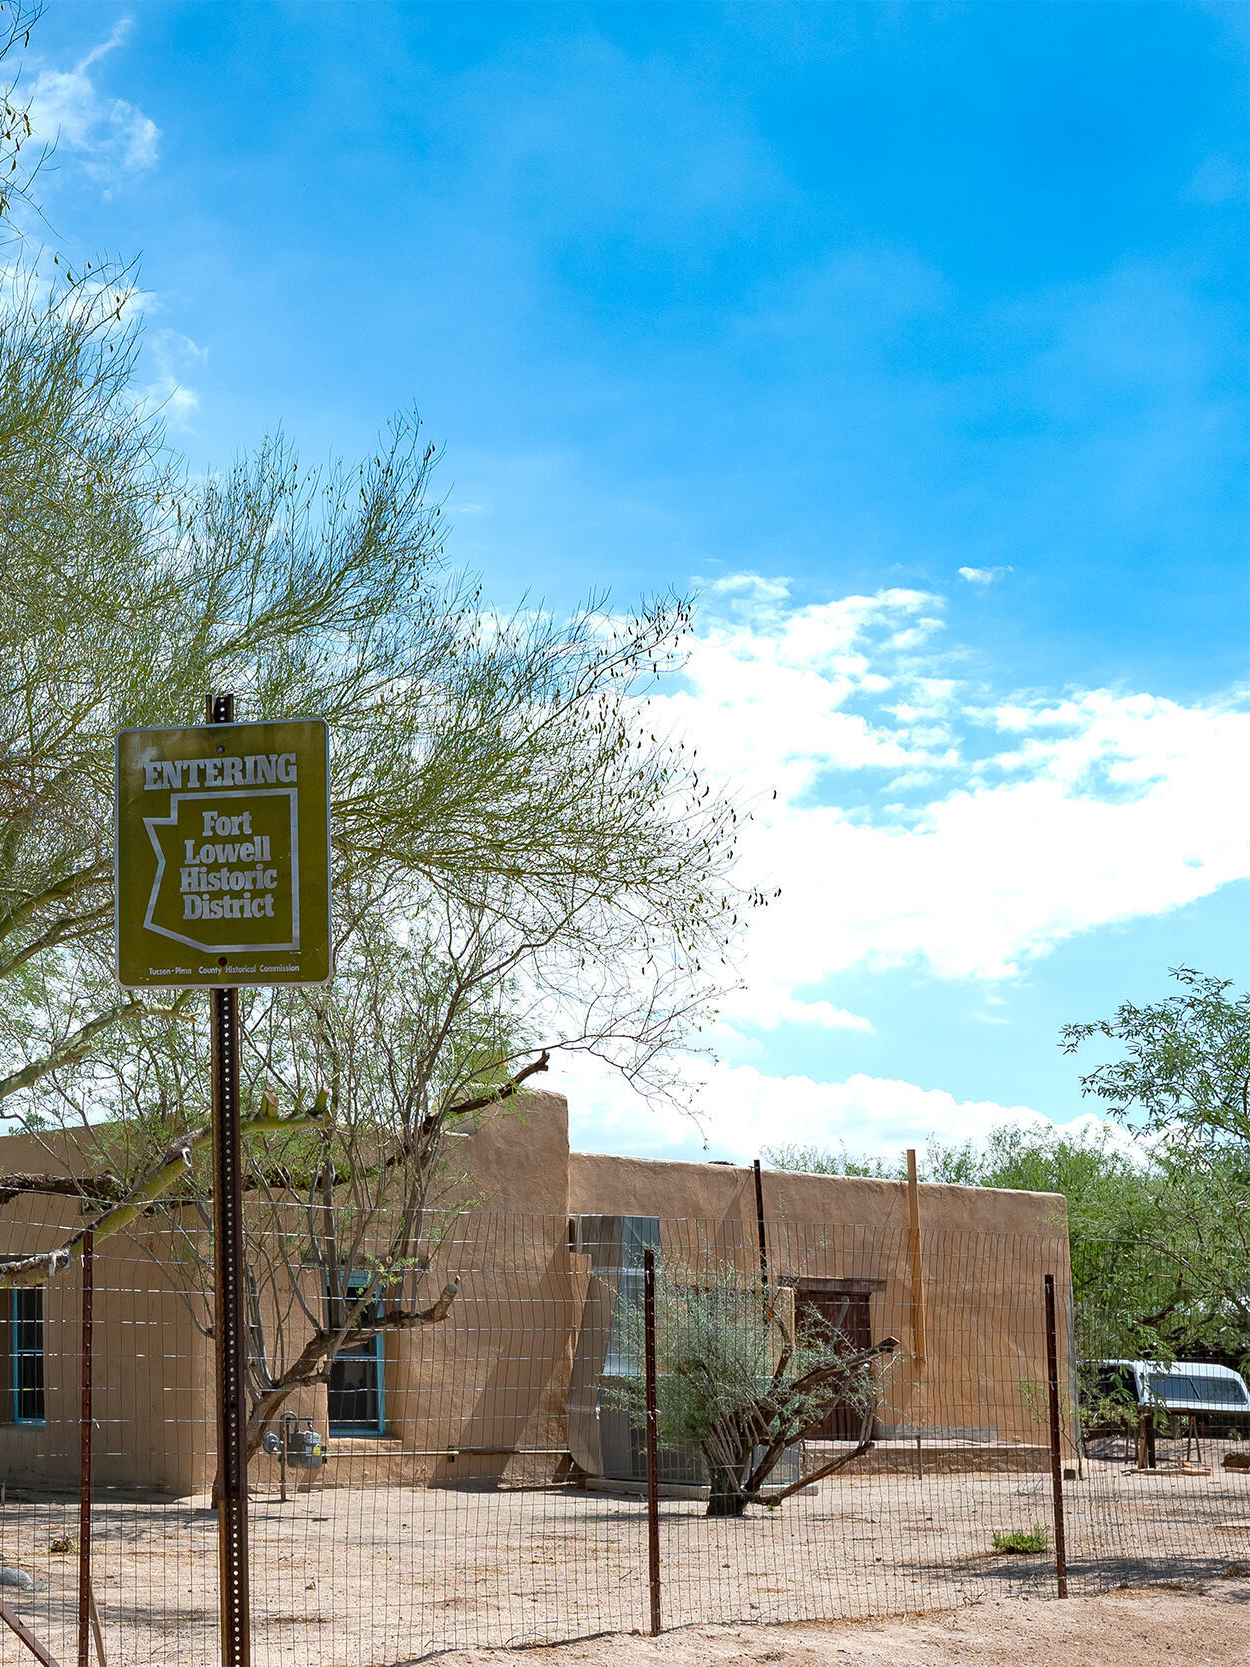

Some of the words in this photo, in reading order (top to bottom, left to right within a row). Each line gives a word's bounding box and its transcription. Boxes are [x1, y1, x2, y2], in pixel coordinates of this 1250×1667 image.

[143, 752, 298, 790] ENTERING
[202, 811, 252, 836] Fort
[184, 836, 271, 864] Lowell
[180, 864, 277, 892] Historic
[183, 893, 275, 920] District
[198, 966, 221, 976] County
[225, 964, 257, 974] Historical
[259, 964, 300, 973] Commission
